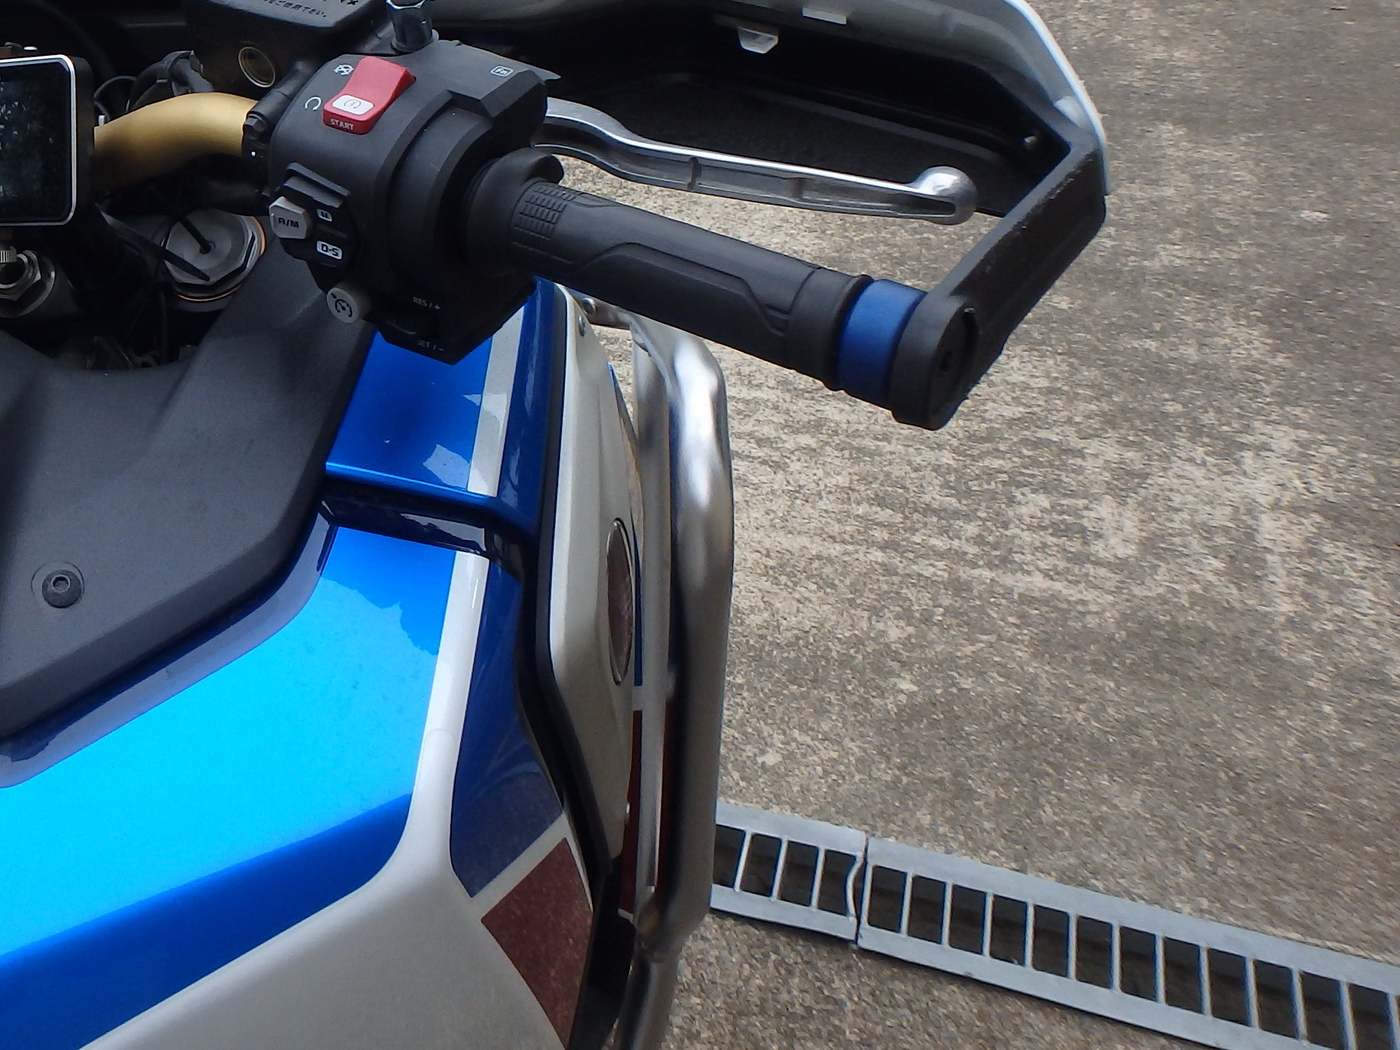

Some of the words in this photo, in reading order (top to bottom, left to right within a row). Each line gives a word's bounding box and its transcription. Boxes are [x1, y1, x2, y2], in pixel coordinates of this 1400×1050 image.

[330, 119, 355, 130] START
[278, 217, 300, 228] A/M
[321, 244, 339, 256] D-S
